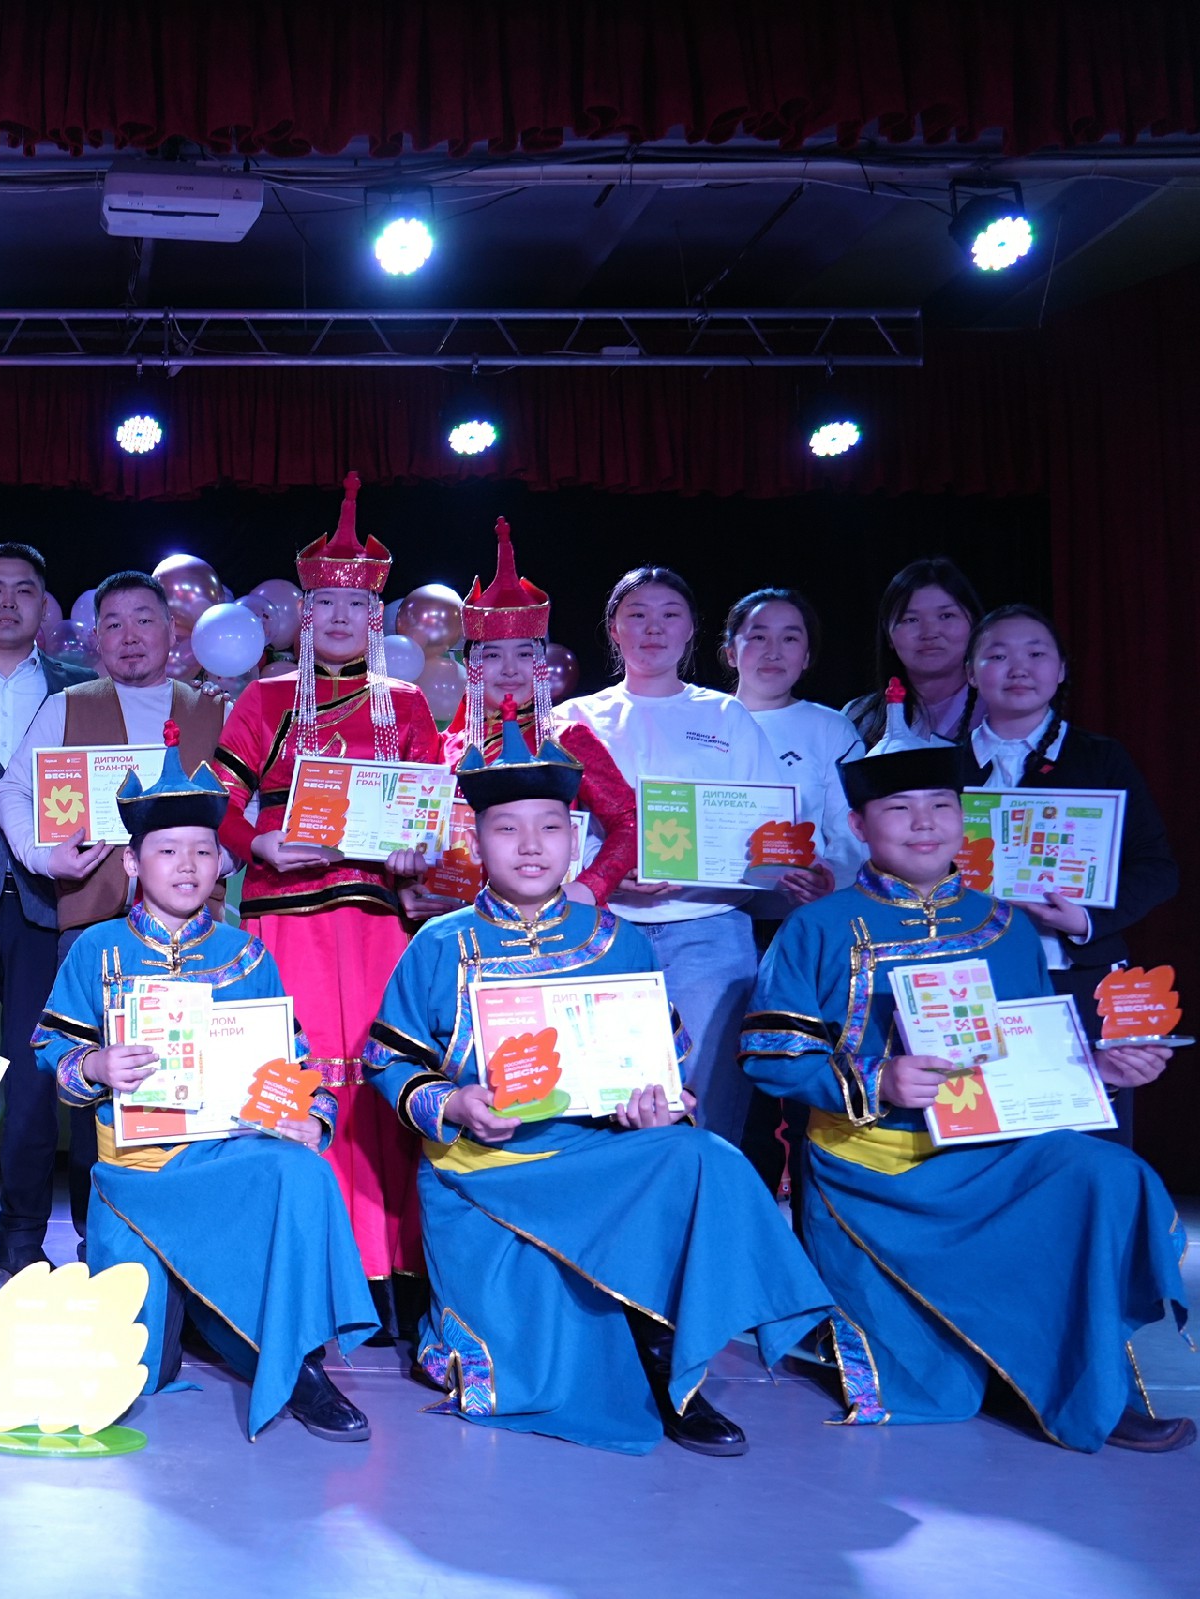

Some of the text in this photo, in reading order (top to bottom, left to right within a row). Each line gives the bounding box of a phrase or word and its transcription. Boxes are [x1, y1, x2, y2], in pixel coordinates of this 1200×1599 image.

[94, 756, 135, 764] ДИПЛОМ
[94, 763, 140, 772] ГРАН-ПРИ
[303, 782, 342, 791] ВЕСНА
[702, 790, 748, 800] ДИПЛОМ
[647, 804, 689, 813] ВЕСНА
[702, 799, 758, 809] ЛАУРЕАТА
[299, 822, 336, 831] ВЕСНА
[762, 847, 804, 856] ВЕСНА
[435, 872, 472, 886] ВЕСНА
[1114, 1003, 1167, 1013] ВЕСНА
[487, 1016, 538, 1026] ВЕСНА
[504, 1064, 549, 1081] ВЕСНА
[260, 1090, 299, 1111] ВЕСНА
